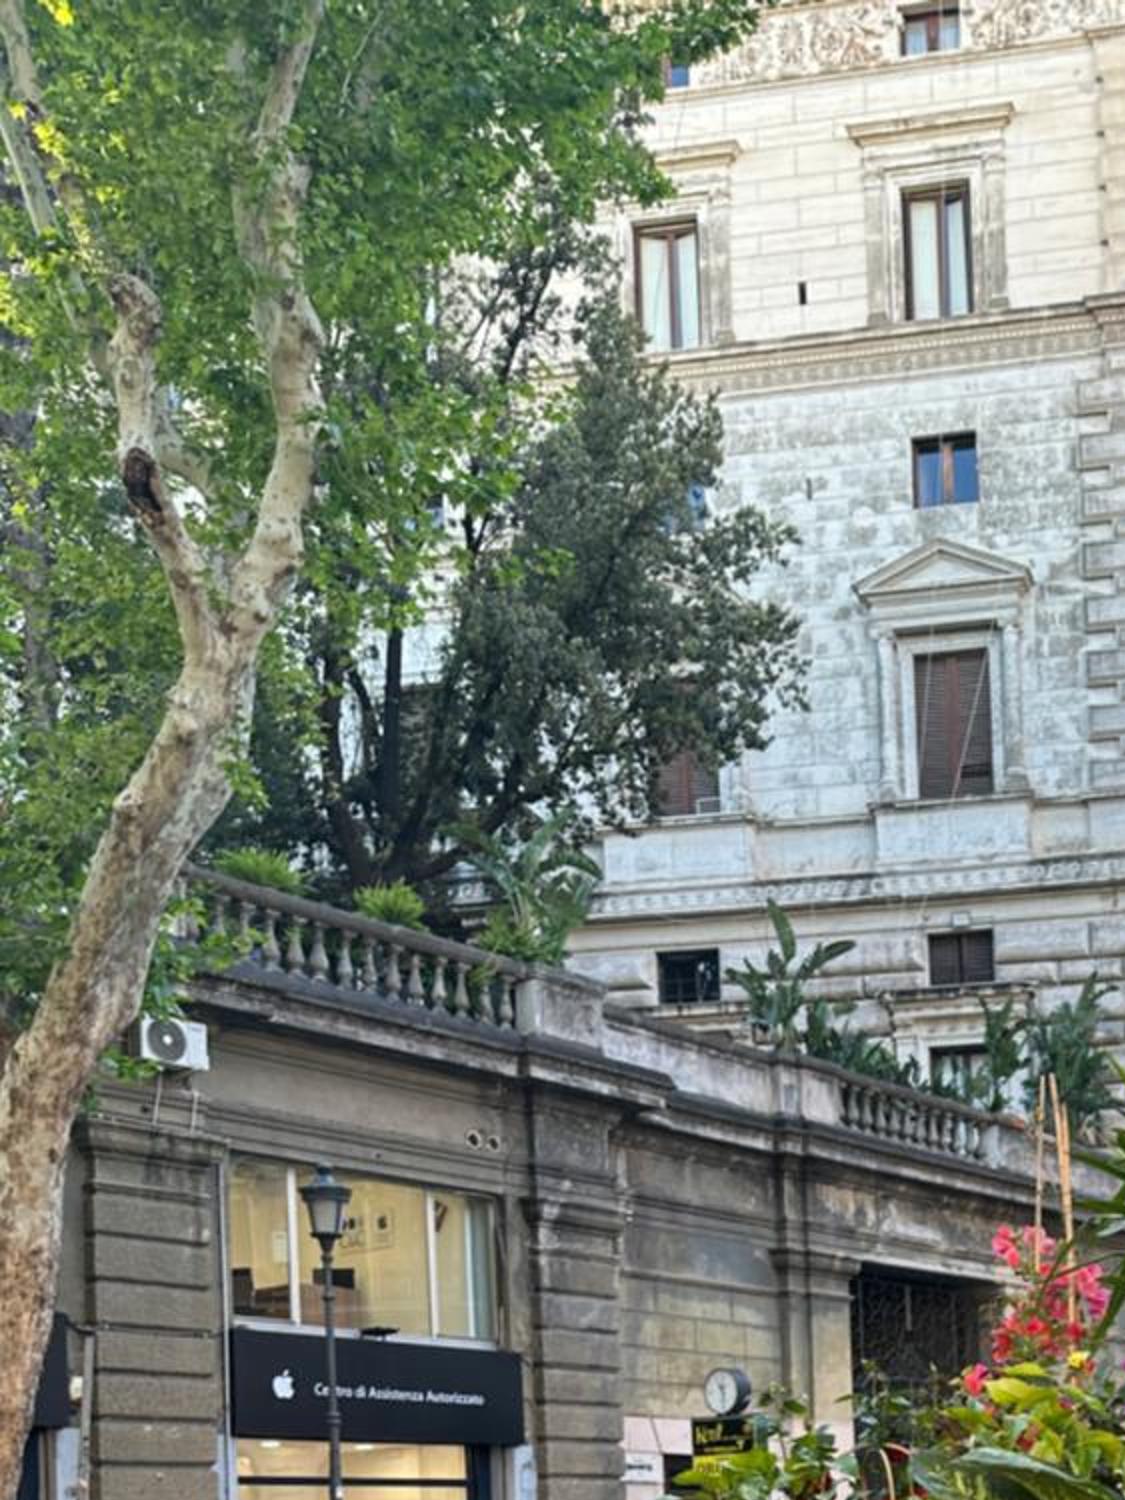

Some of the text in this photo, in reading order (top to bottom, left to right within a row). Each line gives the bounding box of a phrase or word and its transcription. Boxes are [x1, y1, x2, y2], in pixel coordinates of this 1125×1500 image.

[313, 1382, 485, 1406] Cetro di Assistenza Autorizzato
